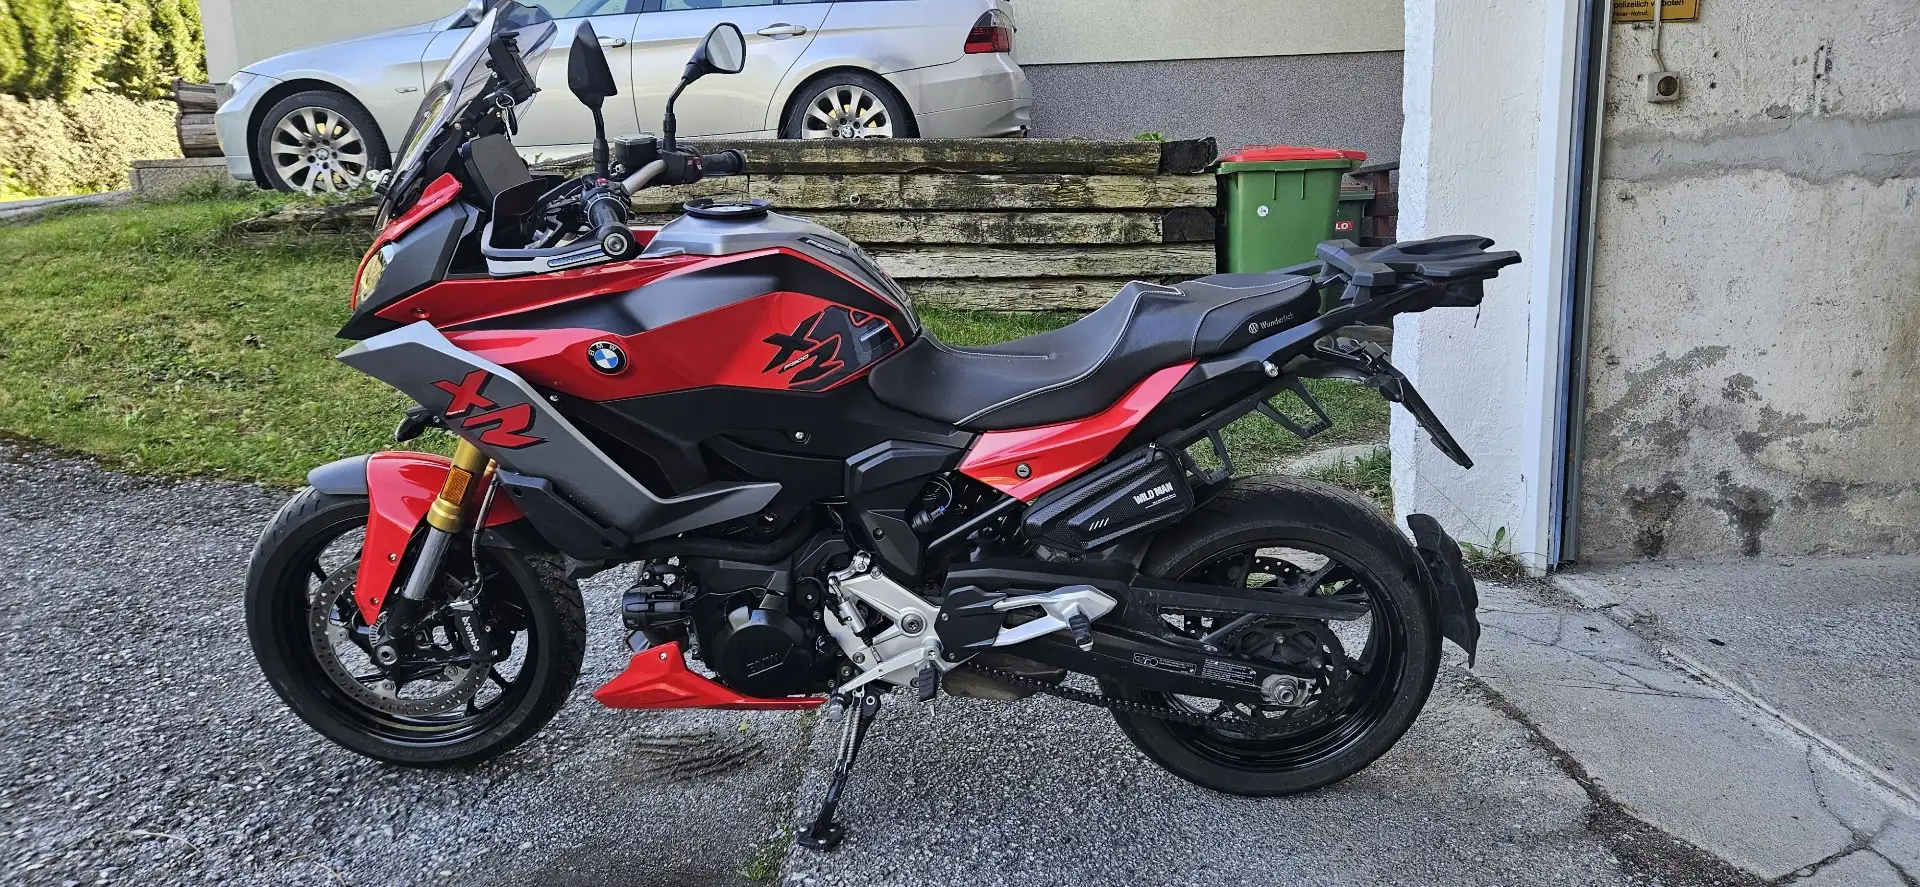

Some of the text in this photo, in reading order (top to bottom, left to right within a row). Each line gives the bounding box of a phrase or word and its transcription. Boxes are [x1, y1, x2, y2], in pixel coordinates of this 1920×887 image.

[1613, 0, 1648, 9] polizeilich
[1259, 311, 1295, 329] Wunderlich
[588, 343, 617, 358] BMW
[1133, 489, 1155, 505] WILD
[1152, 481, 1174, 497] MAN
[461, 616, 480, 651] brembo
